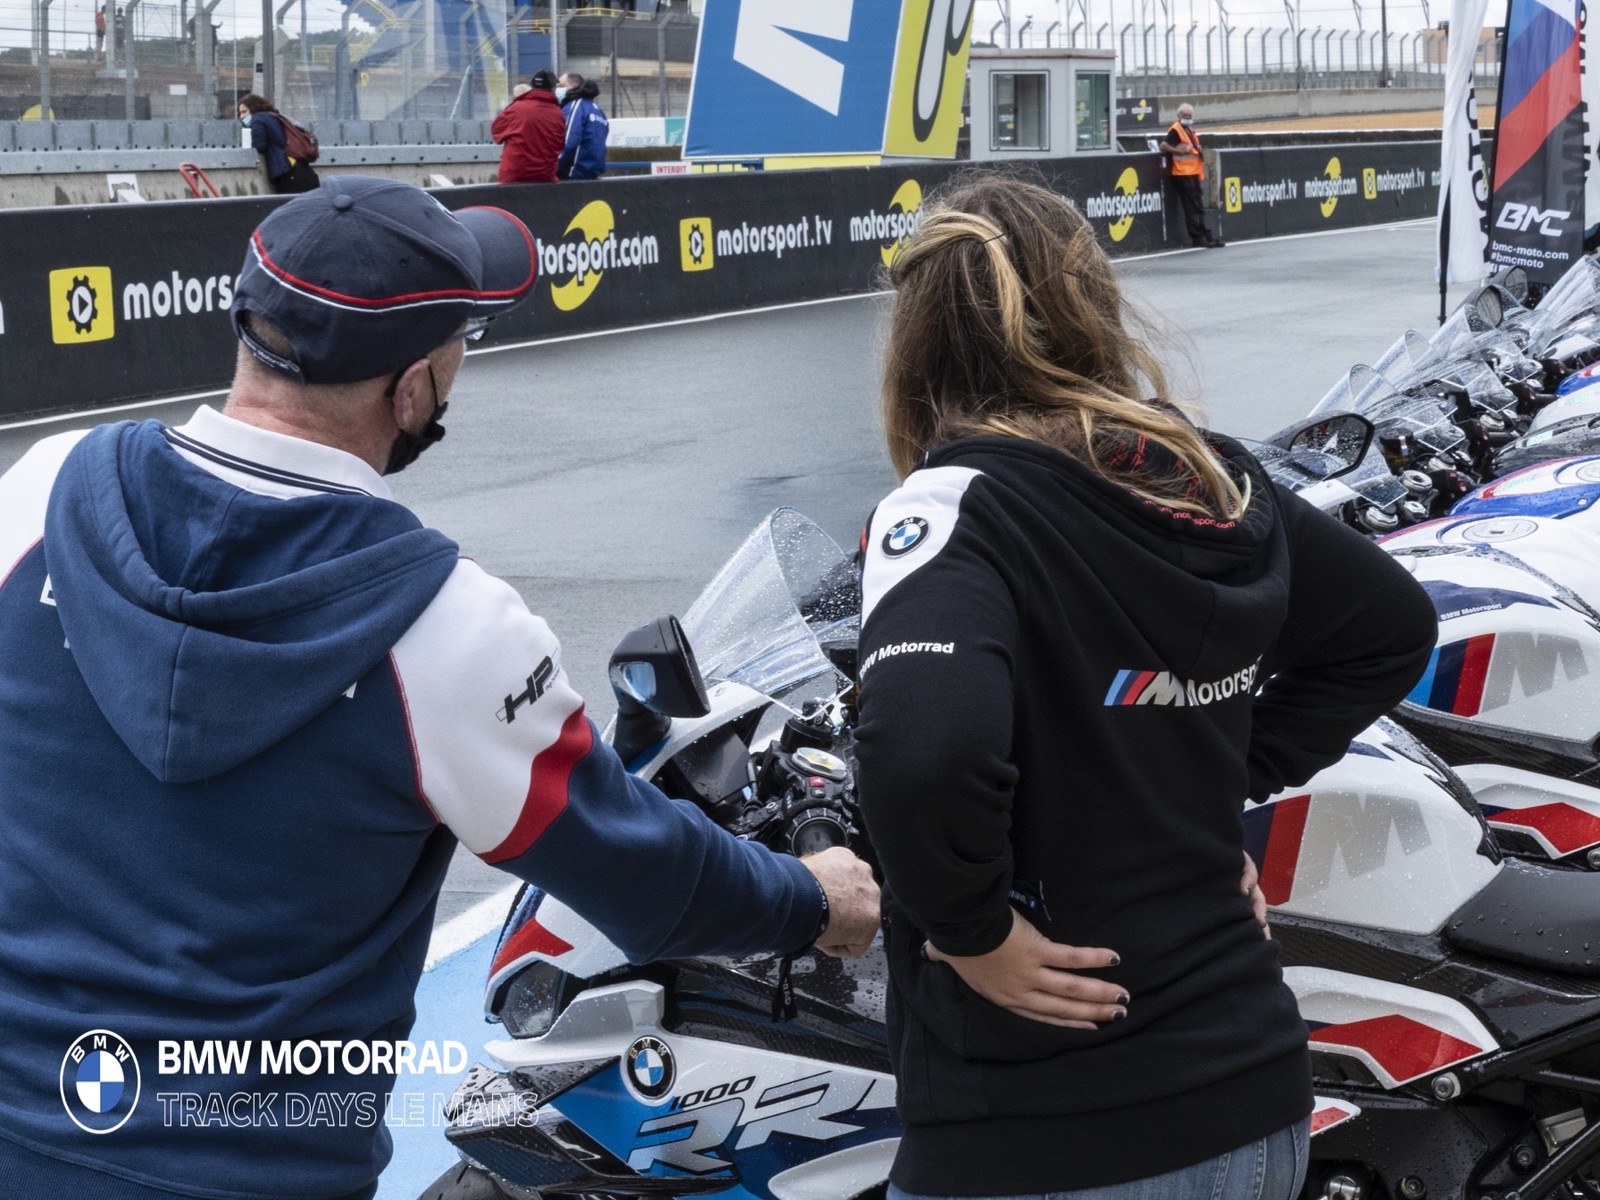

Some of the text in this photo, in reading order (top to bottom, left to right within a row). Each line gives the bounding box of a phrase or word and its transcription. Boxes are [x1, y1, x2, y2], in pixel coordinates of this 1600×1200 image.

[656, 165, 687, 175] INTERDIT
[1376, 167, 1426, 195] motorsport.tv
[1242, 178, 1298, 207] motorsport.tv
[1304, 176, 1358, 199] motorsport.com
[1087, 189, 1162, 222] motorsport.com
[1495, 202, 1571, 237] BMC
[717, 214, 833, 259] motorsport.tv
[1492, 240, 1569, 260] bmc-moto.com
[1491, 252, 1544, 269] #bmcmoto
[123, 270, 241, 321] motors
[1440, 603, 1503, 621] BMW Motorsport
[878, 642, 955, 663] Motorrad
[504, 655, 554, 725] HP
[629, 1037, 668, 1059] BMW
[669, 1076, 756, 1112] 1000
